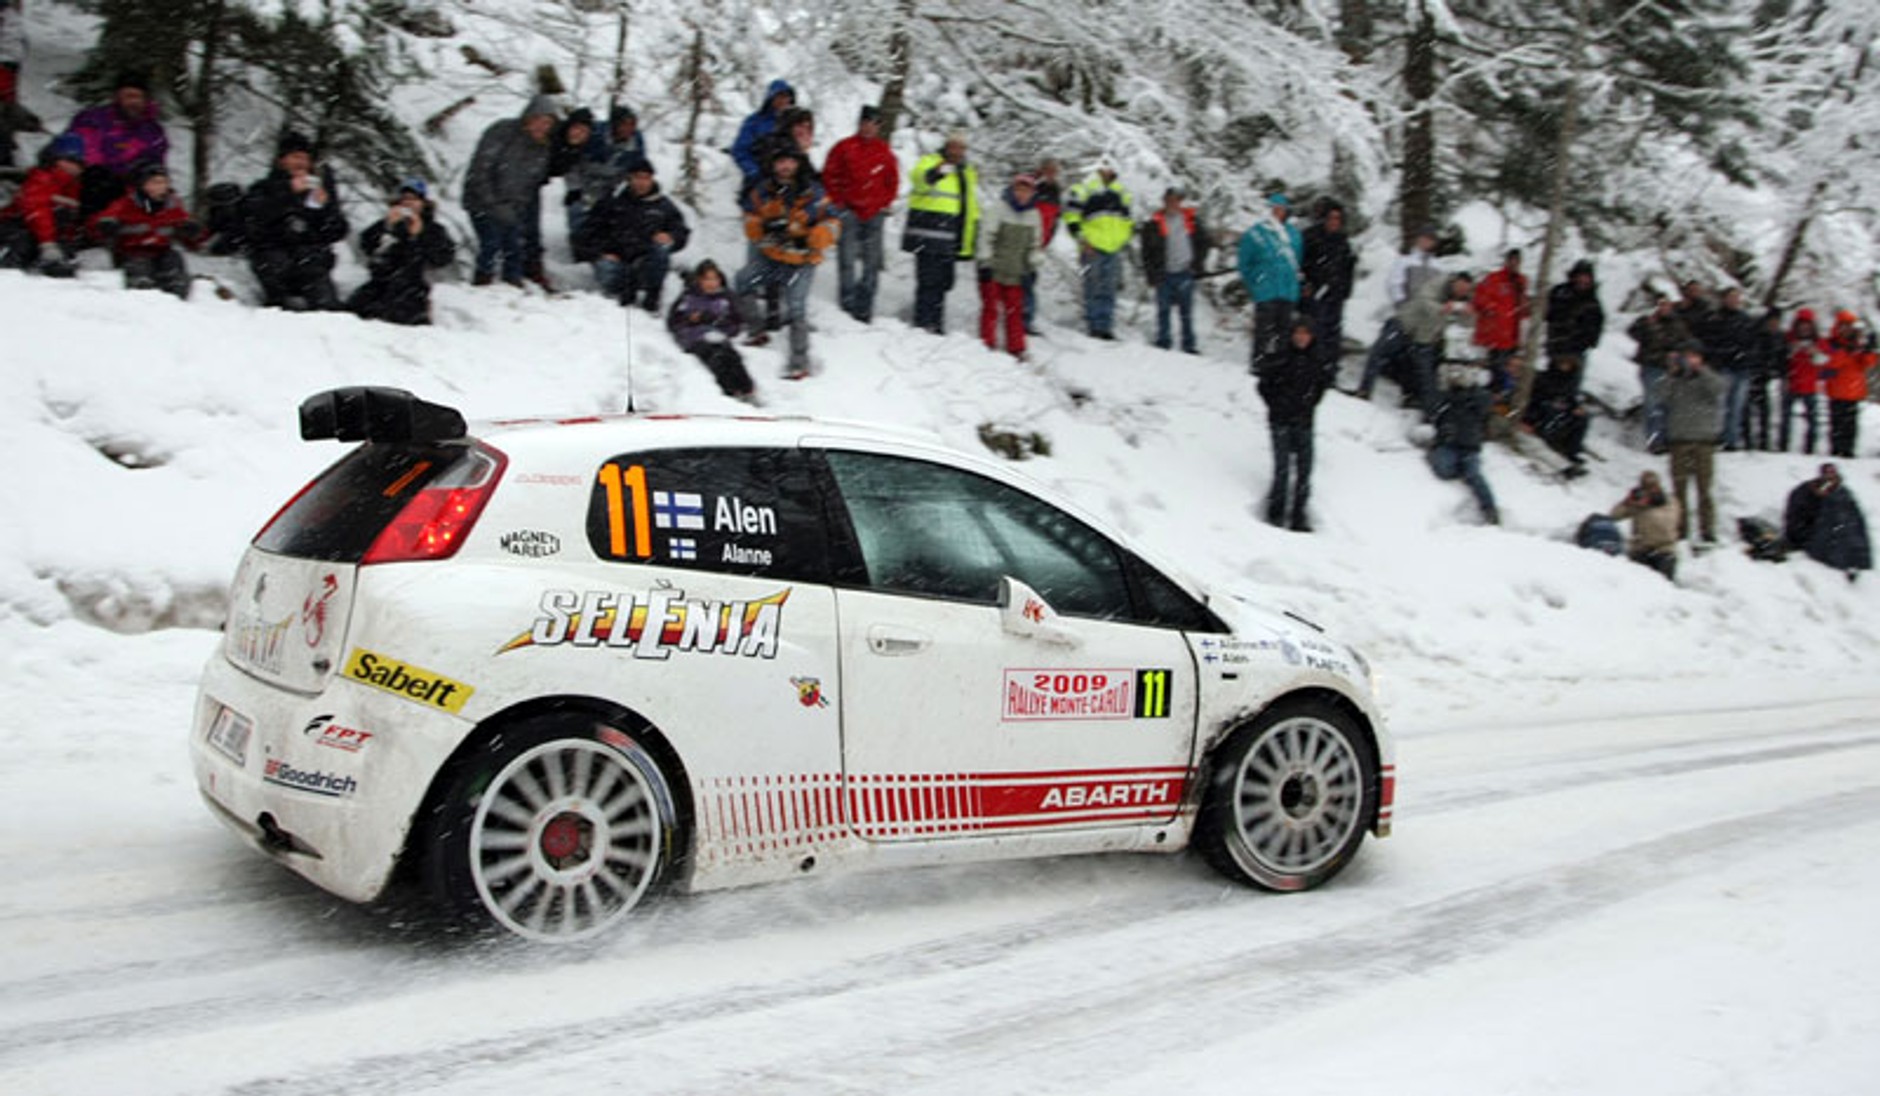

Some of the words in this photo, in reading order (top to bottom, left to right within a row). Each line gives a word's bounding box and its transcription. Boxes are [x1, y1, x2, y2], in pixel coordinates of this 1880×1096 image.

[598, 463, 651, 557] 11
[714, 495, 777, 535] Alen
[722, 543, 772, 566] Alanne
[353, 653, 457, 707] Sabelt
[1024, 674, 1107, 694] 2009
[1143, 670, 1165, 717] 11
[1008, 680, 1047, 715] RALLYE
[1050, 680, 1129, 715] MONTE-CARLO
[324, 724, 373, 744] FPT
[264, 758, 357, 792] BFGoodrich
[1039, 782, 1170, 809] ABARTH
